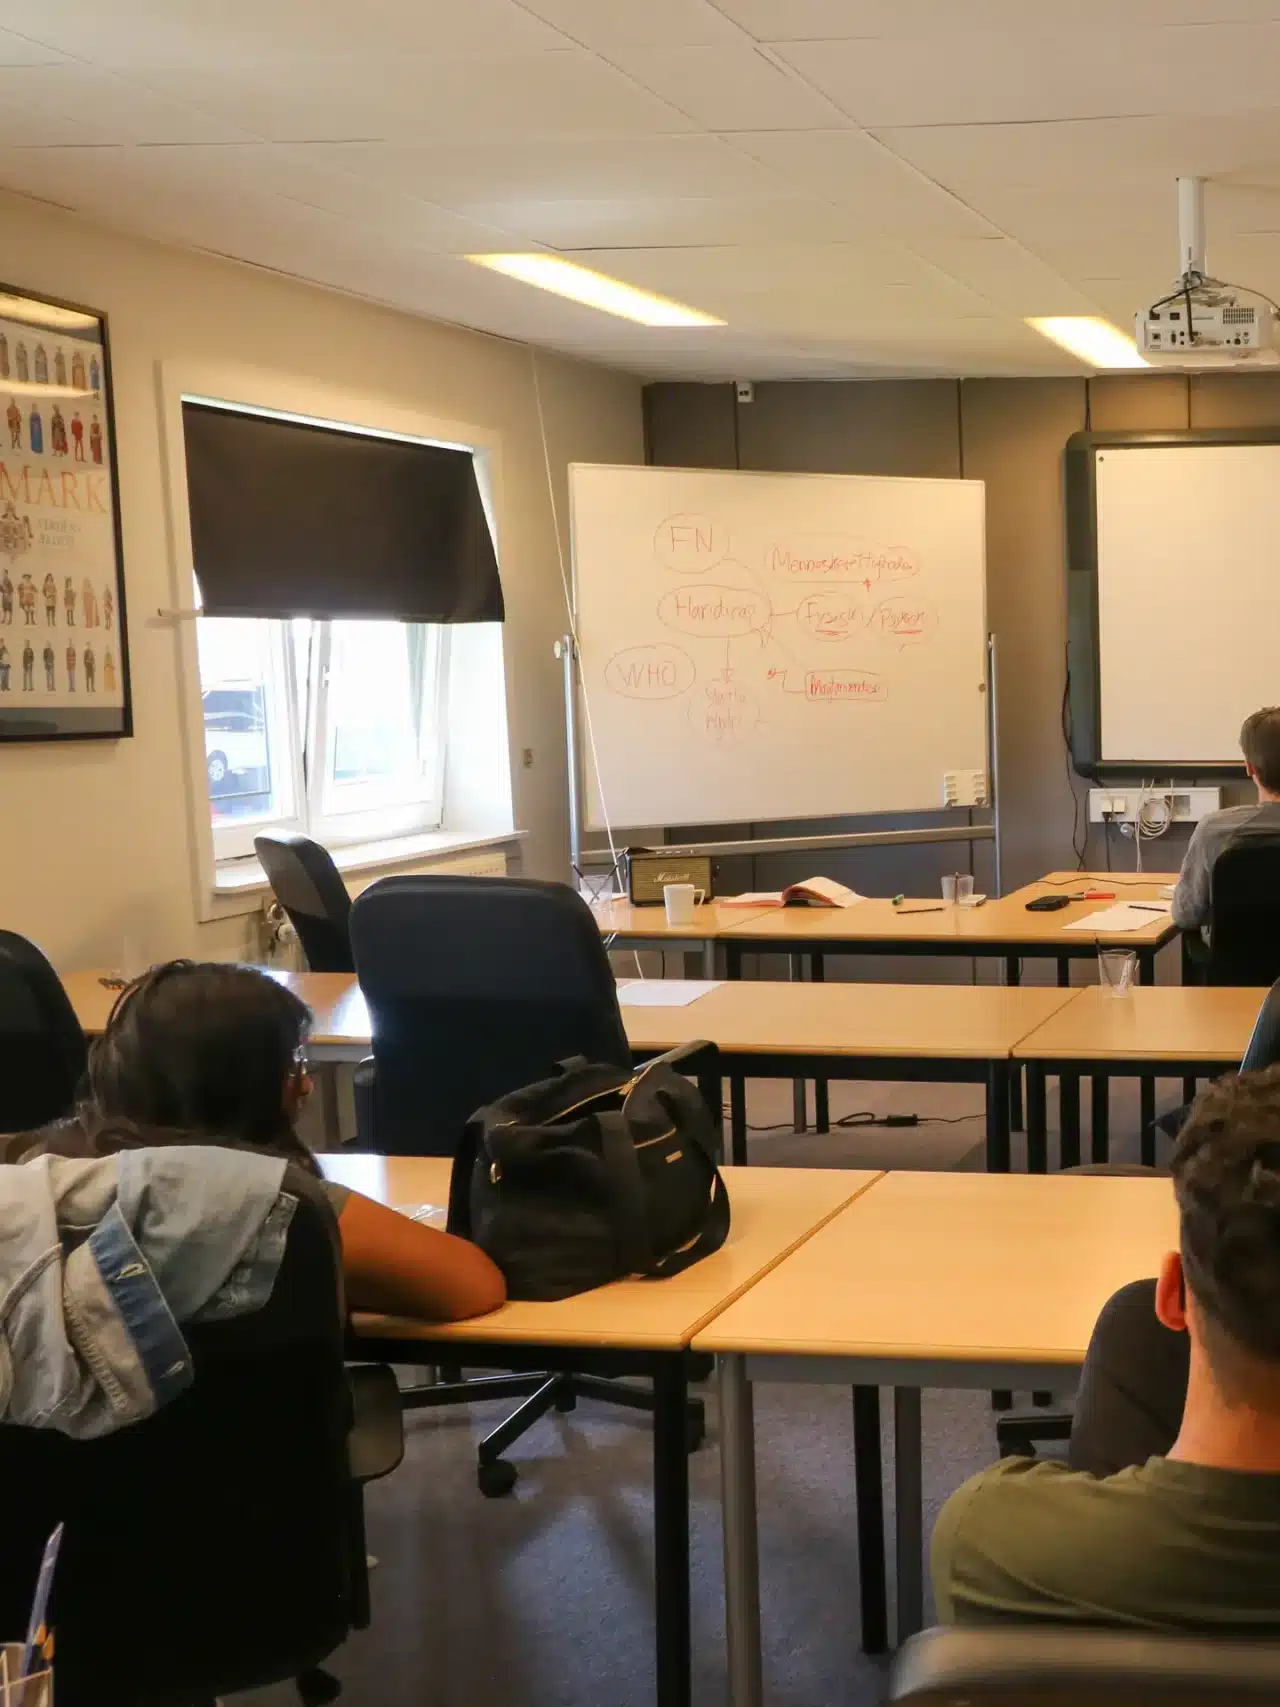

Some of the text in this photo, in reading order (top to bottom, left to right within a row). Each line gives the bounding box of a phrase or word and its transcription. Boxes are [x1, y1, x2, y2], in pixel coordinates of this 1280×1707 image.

[0, 462, 108, 514] MARK
[670, 524, 713, 552] FN
[616, 660, 677, 688] WHO
